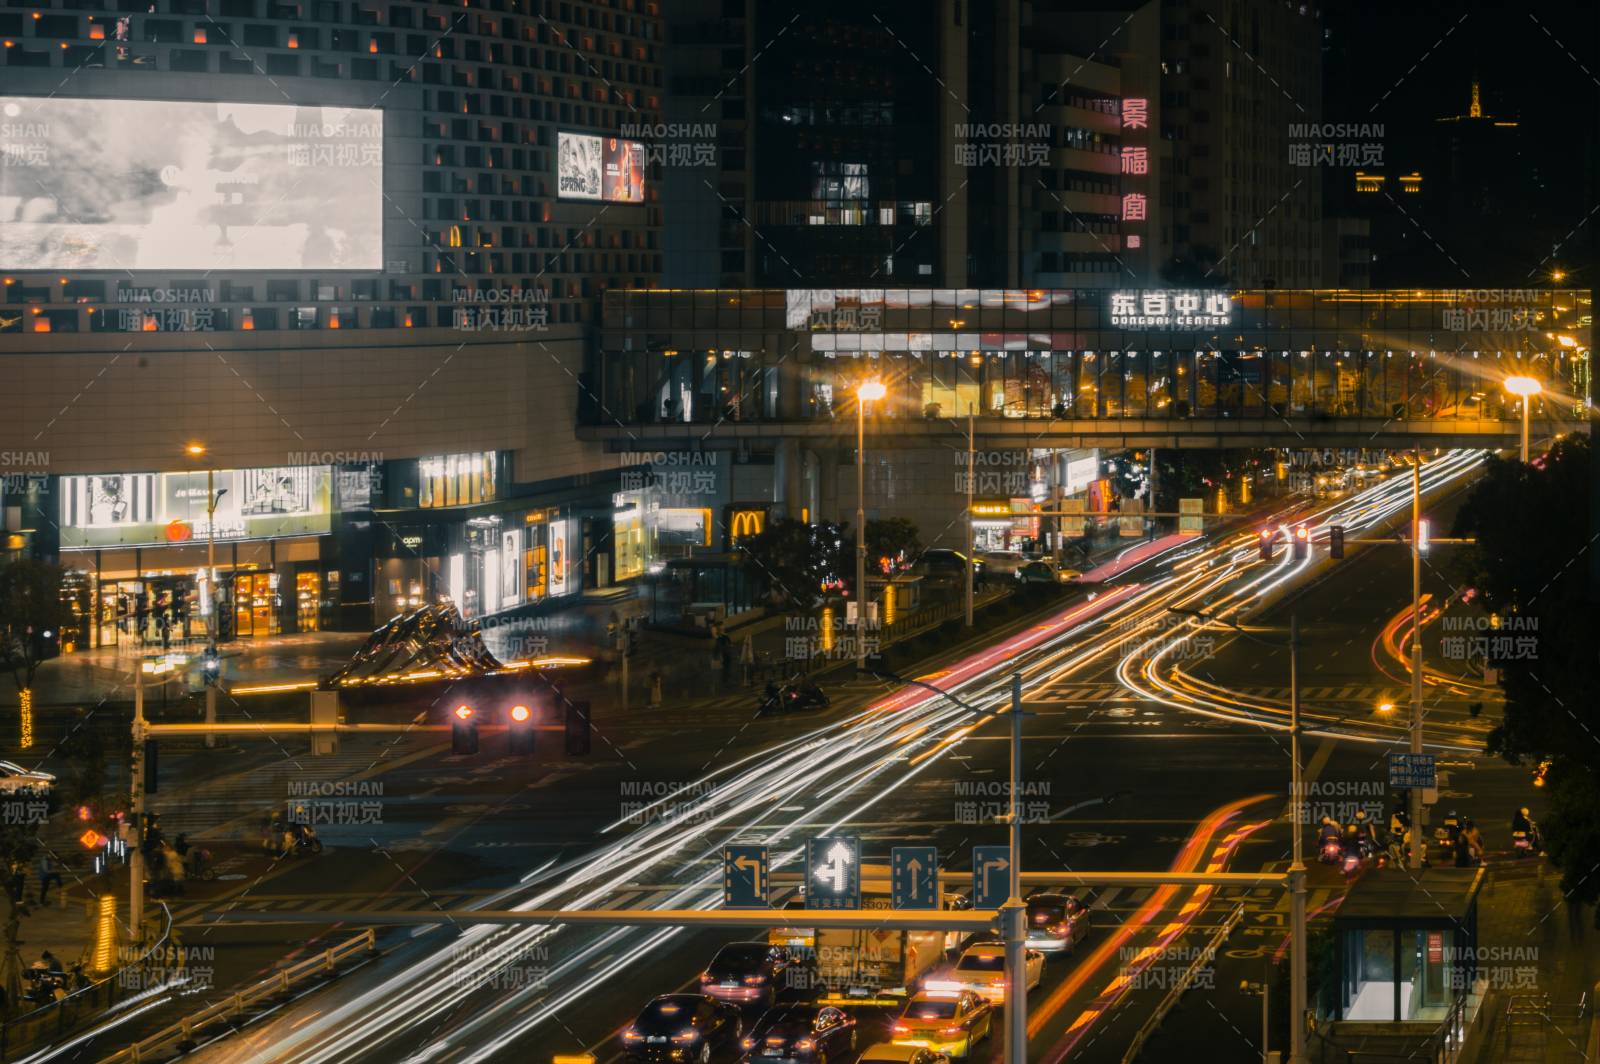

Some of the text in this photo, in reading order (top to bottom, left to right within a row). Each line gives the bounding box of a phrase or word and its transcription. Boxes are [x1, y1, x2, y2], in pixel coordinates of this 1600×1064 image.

[1121, 98, 1148, 221] 景福堂
[560, 177, 586, 193] SPRING
[1111, 293, 1229, 315] 东百中心
[1112, 316, 1169, 325] DONGBAI
[1177, 316, 1228, 325] CENTER
